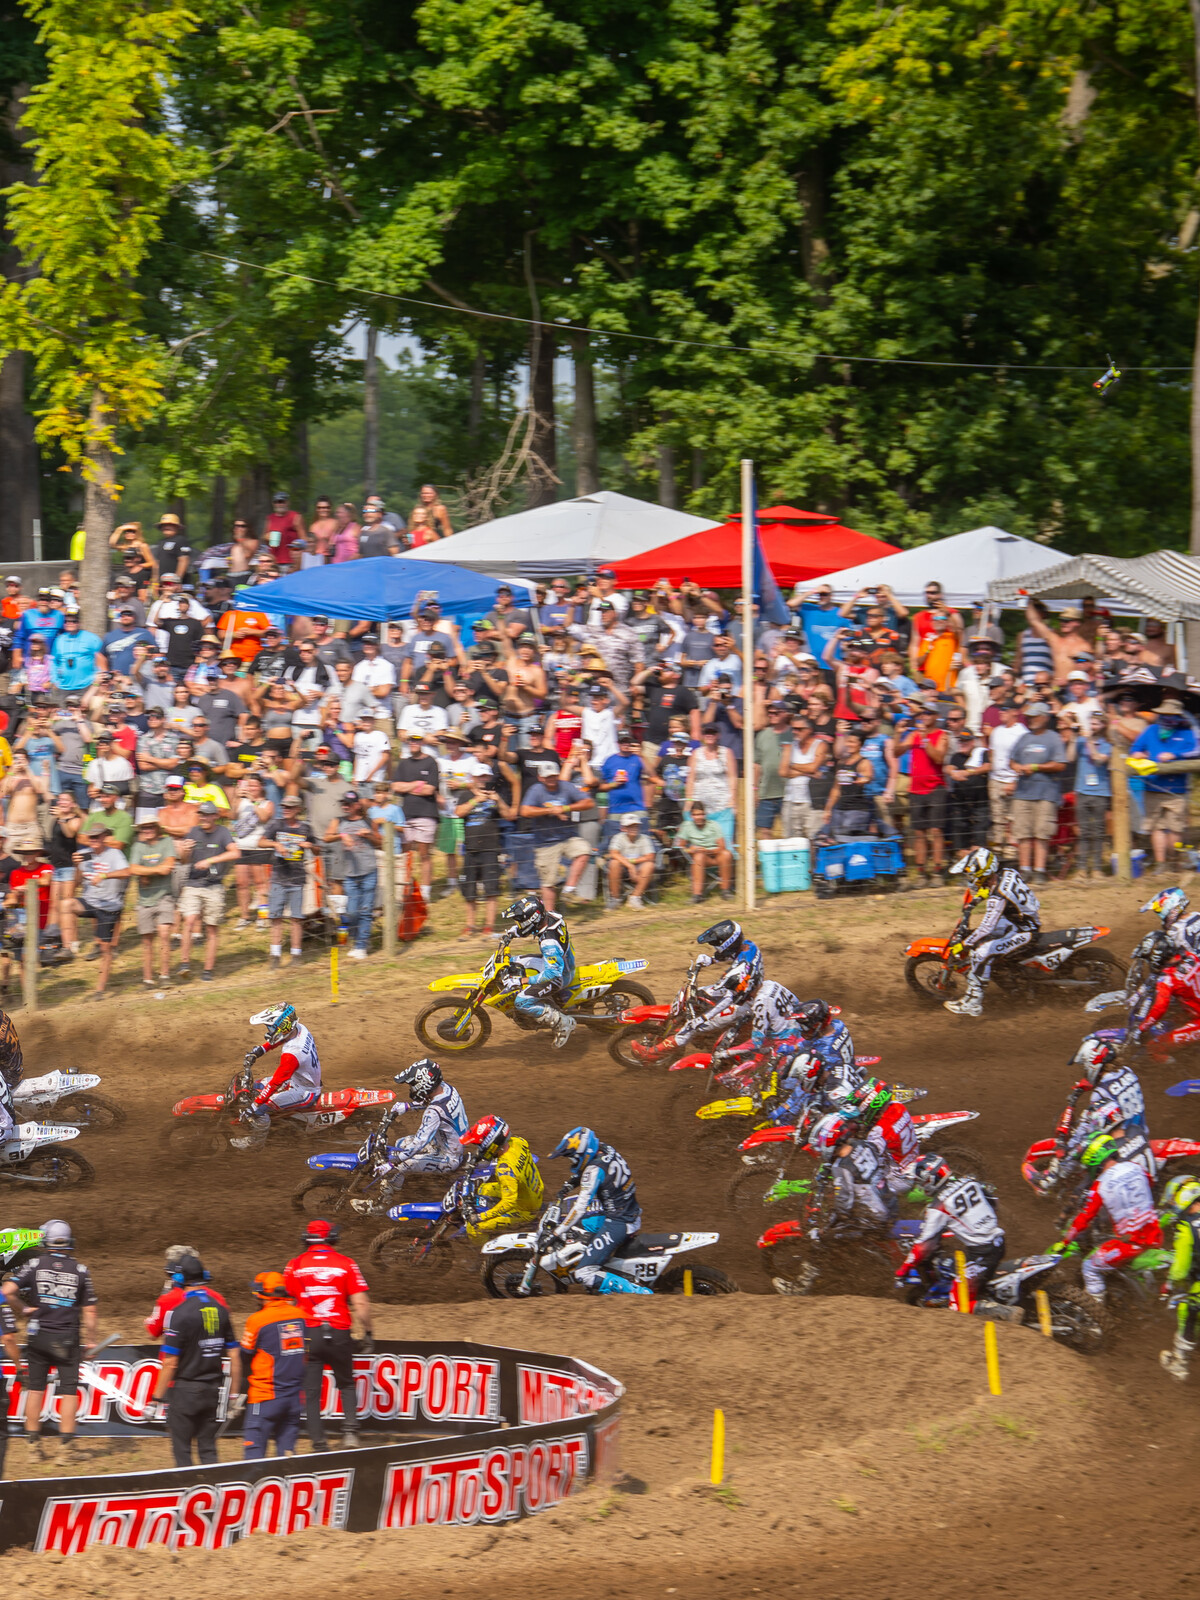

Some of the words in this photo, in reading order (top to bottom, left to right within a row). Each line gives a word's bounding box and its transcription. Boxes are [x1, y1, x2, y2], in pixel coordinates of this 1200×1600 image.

[538, 984, 553, 998] FLY
[586, 988, 601, 999] 11
[9, 1150, 26, 1161] 91
[953, 1184, 980, 1217] 92
[585, 1231, 615, 1257] FOX
[634, 1262, 658, 1279] 28
[36, 1281, 78, 1300] FXR
[377, 1432, 589, 1530] MOTOSPORT
